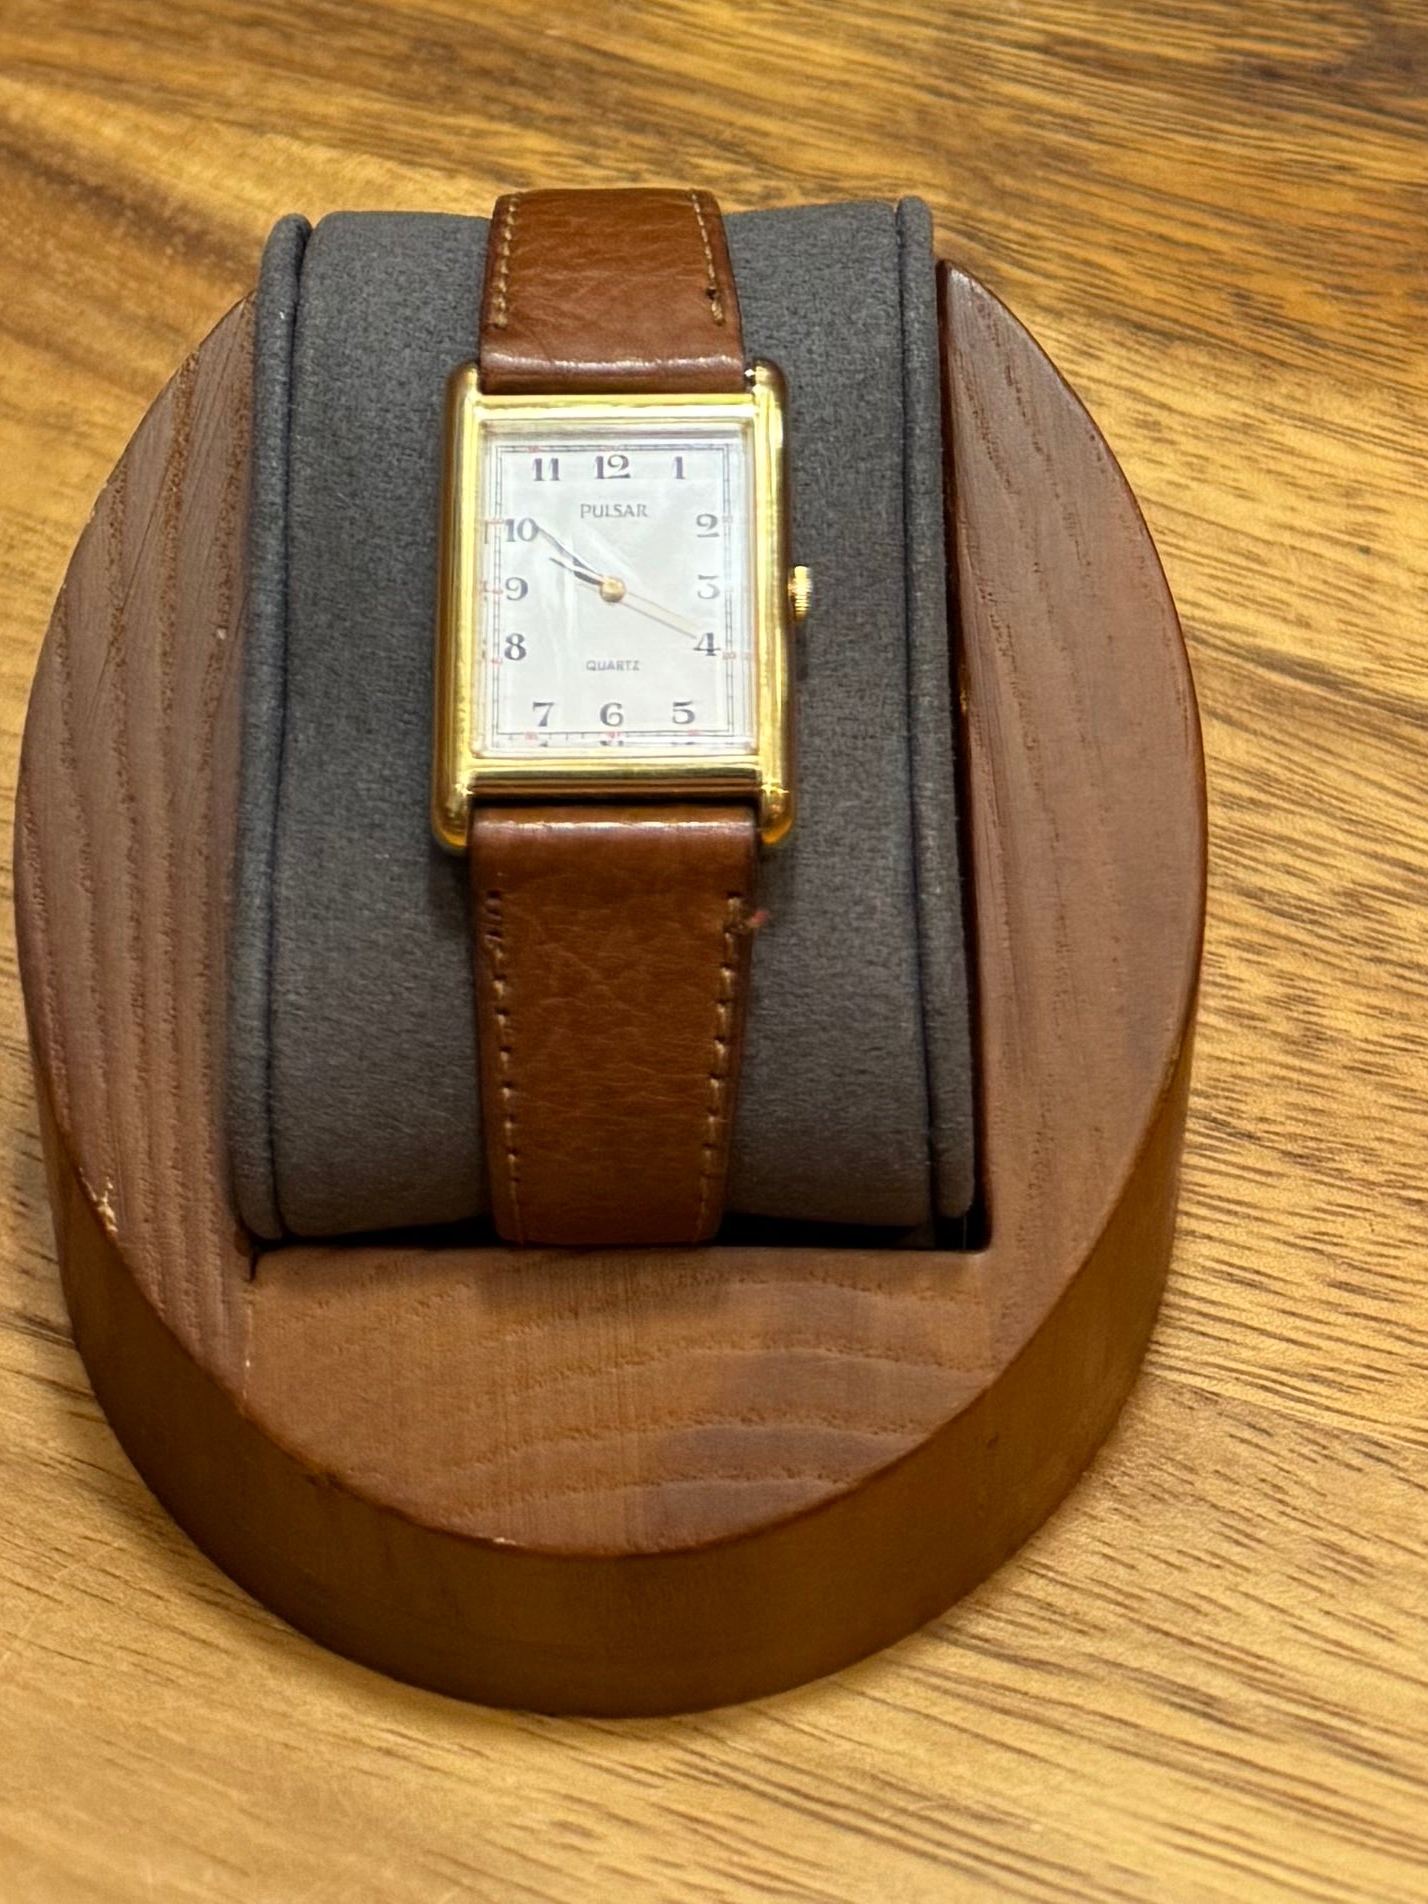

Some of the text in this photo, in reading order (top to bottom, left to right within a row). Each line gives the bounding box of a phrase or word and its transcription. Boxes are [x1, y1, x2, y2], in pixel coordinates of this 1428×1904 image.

[532, 457, 561, 482] 11
[594, 454, 631, 480] 12
[674, 455, 686, 480] 1
[579, 503, 649, 519] PULSAR
[504, 518, 539, 543] 10
[695, 512, 720, 538] 2
[504, 576, 529, 601] 9
[697, 574, 721, 600] 3
[503, 632, 528, 662] 8
[692, 632, 721, 657] 4
[585, 659, 641, 672] QUARTZ
[532, 701, 555, 727] 7
[599, 702, 624, 727] 6
[672, 700, 697, 725] 5
